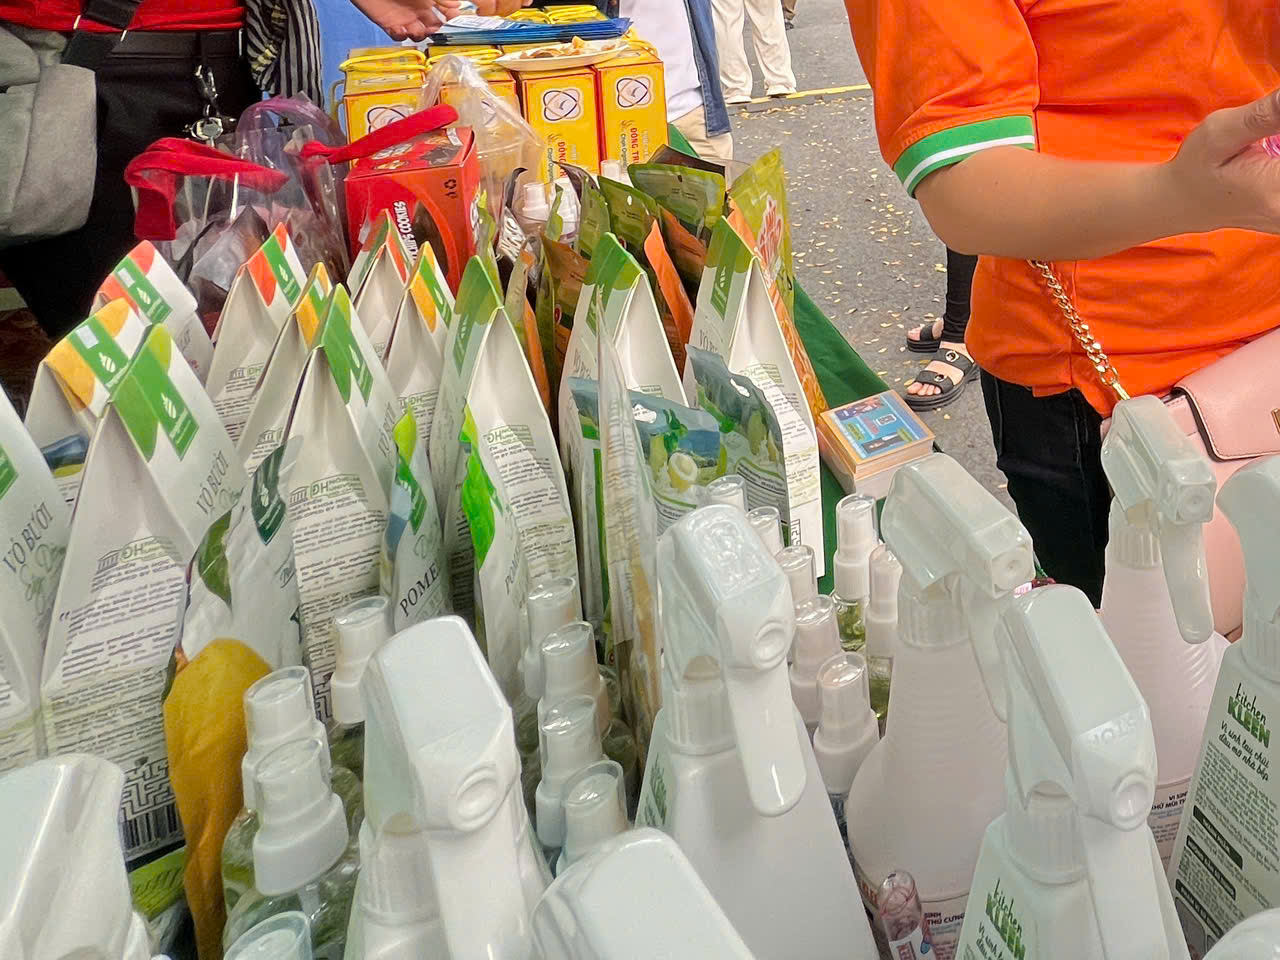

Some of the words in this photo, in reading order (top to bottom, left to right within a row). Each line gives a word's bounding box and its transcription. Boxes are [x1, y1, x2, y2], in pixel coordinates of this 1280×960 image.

[393, 200, 413, 234] COOKIES
[1227, 695, 1271, 749] KLEEN
[1235, 682, 1267, 726] kitchen
[985, 892, 1027, 960] KLEEN
[993, 877, 1023, 937] kitchen
